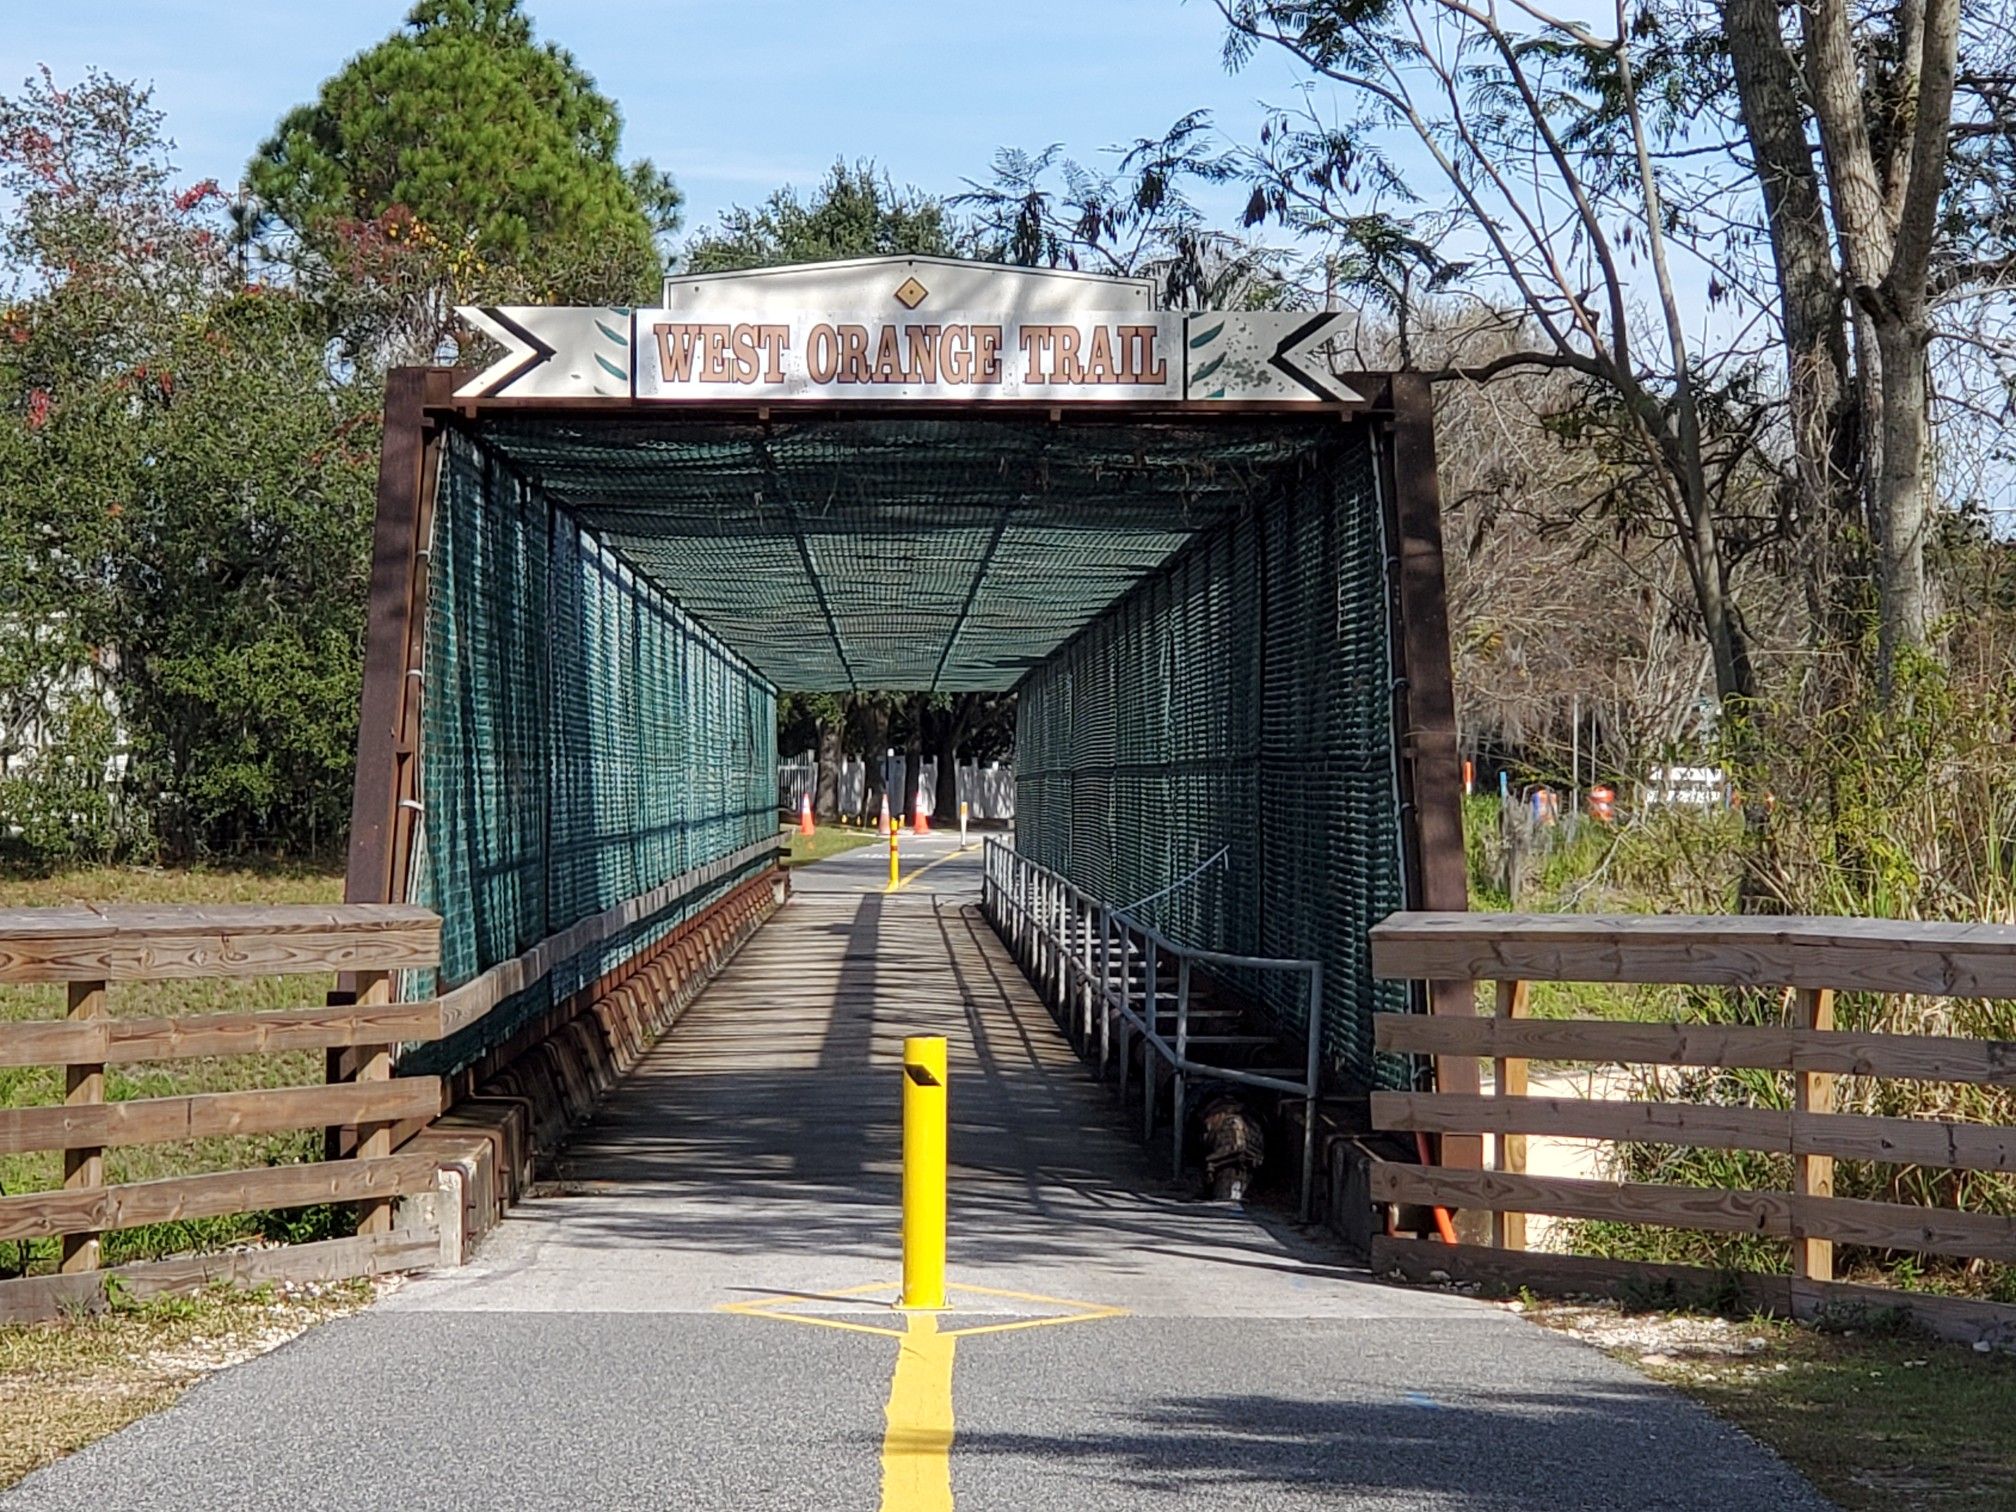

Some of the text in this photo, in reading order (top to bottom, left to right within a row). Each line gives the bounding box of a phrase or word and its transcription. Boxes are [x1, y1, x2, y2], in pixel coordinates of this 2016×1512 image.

[653, 323, 1167, 384] WEST ORANGE TRAIL
